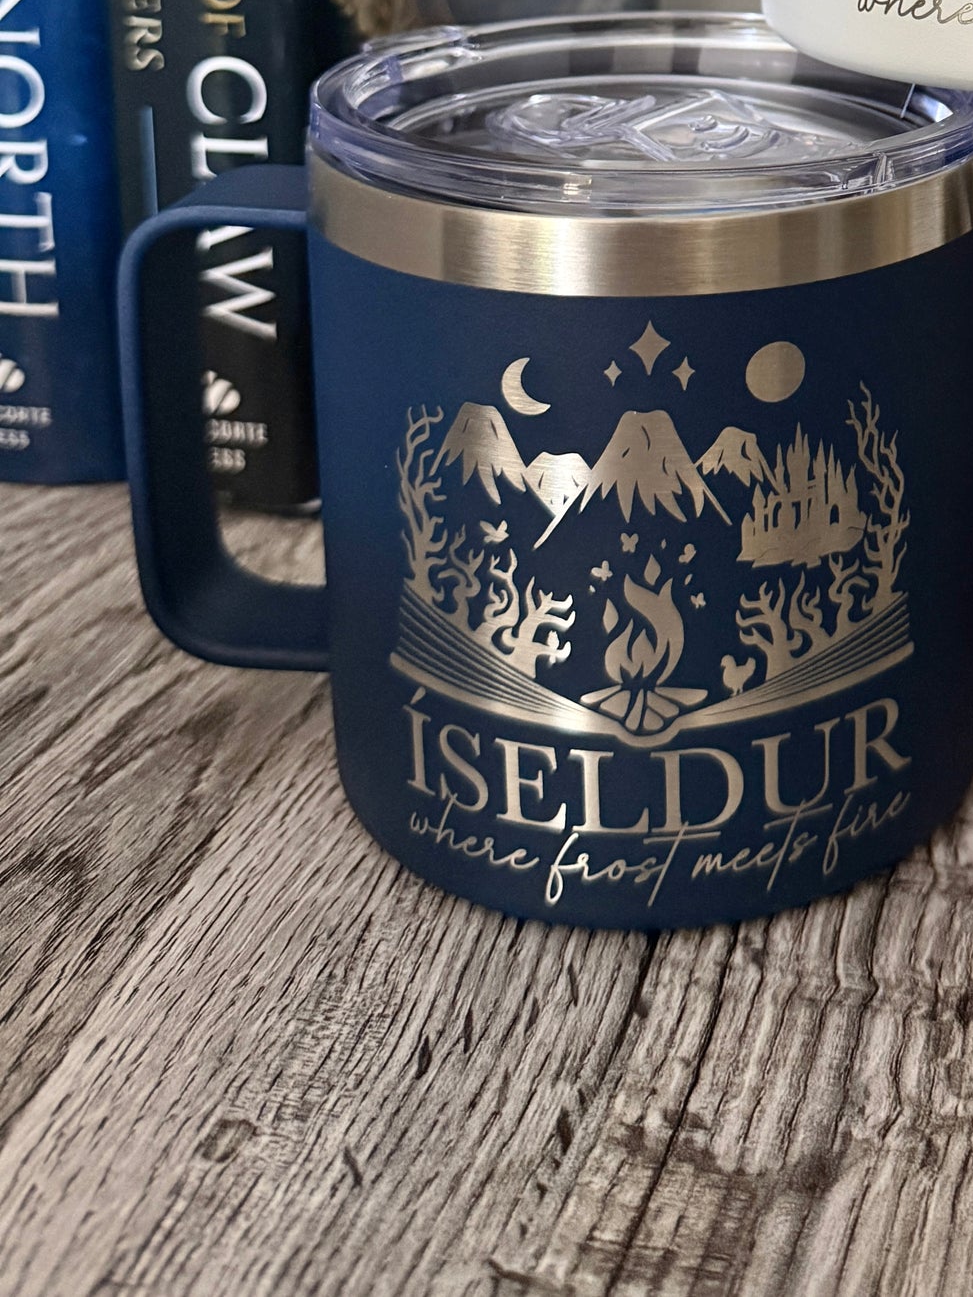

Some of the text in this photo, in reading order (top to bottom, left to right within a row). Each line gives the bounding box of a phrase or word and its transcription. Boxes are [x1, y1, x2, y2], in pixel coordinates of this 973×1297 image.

[401, 687, 911, 835] ÍSELDUR
[409, 791, 911, 907] where frost meets fire
